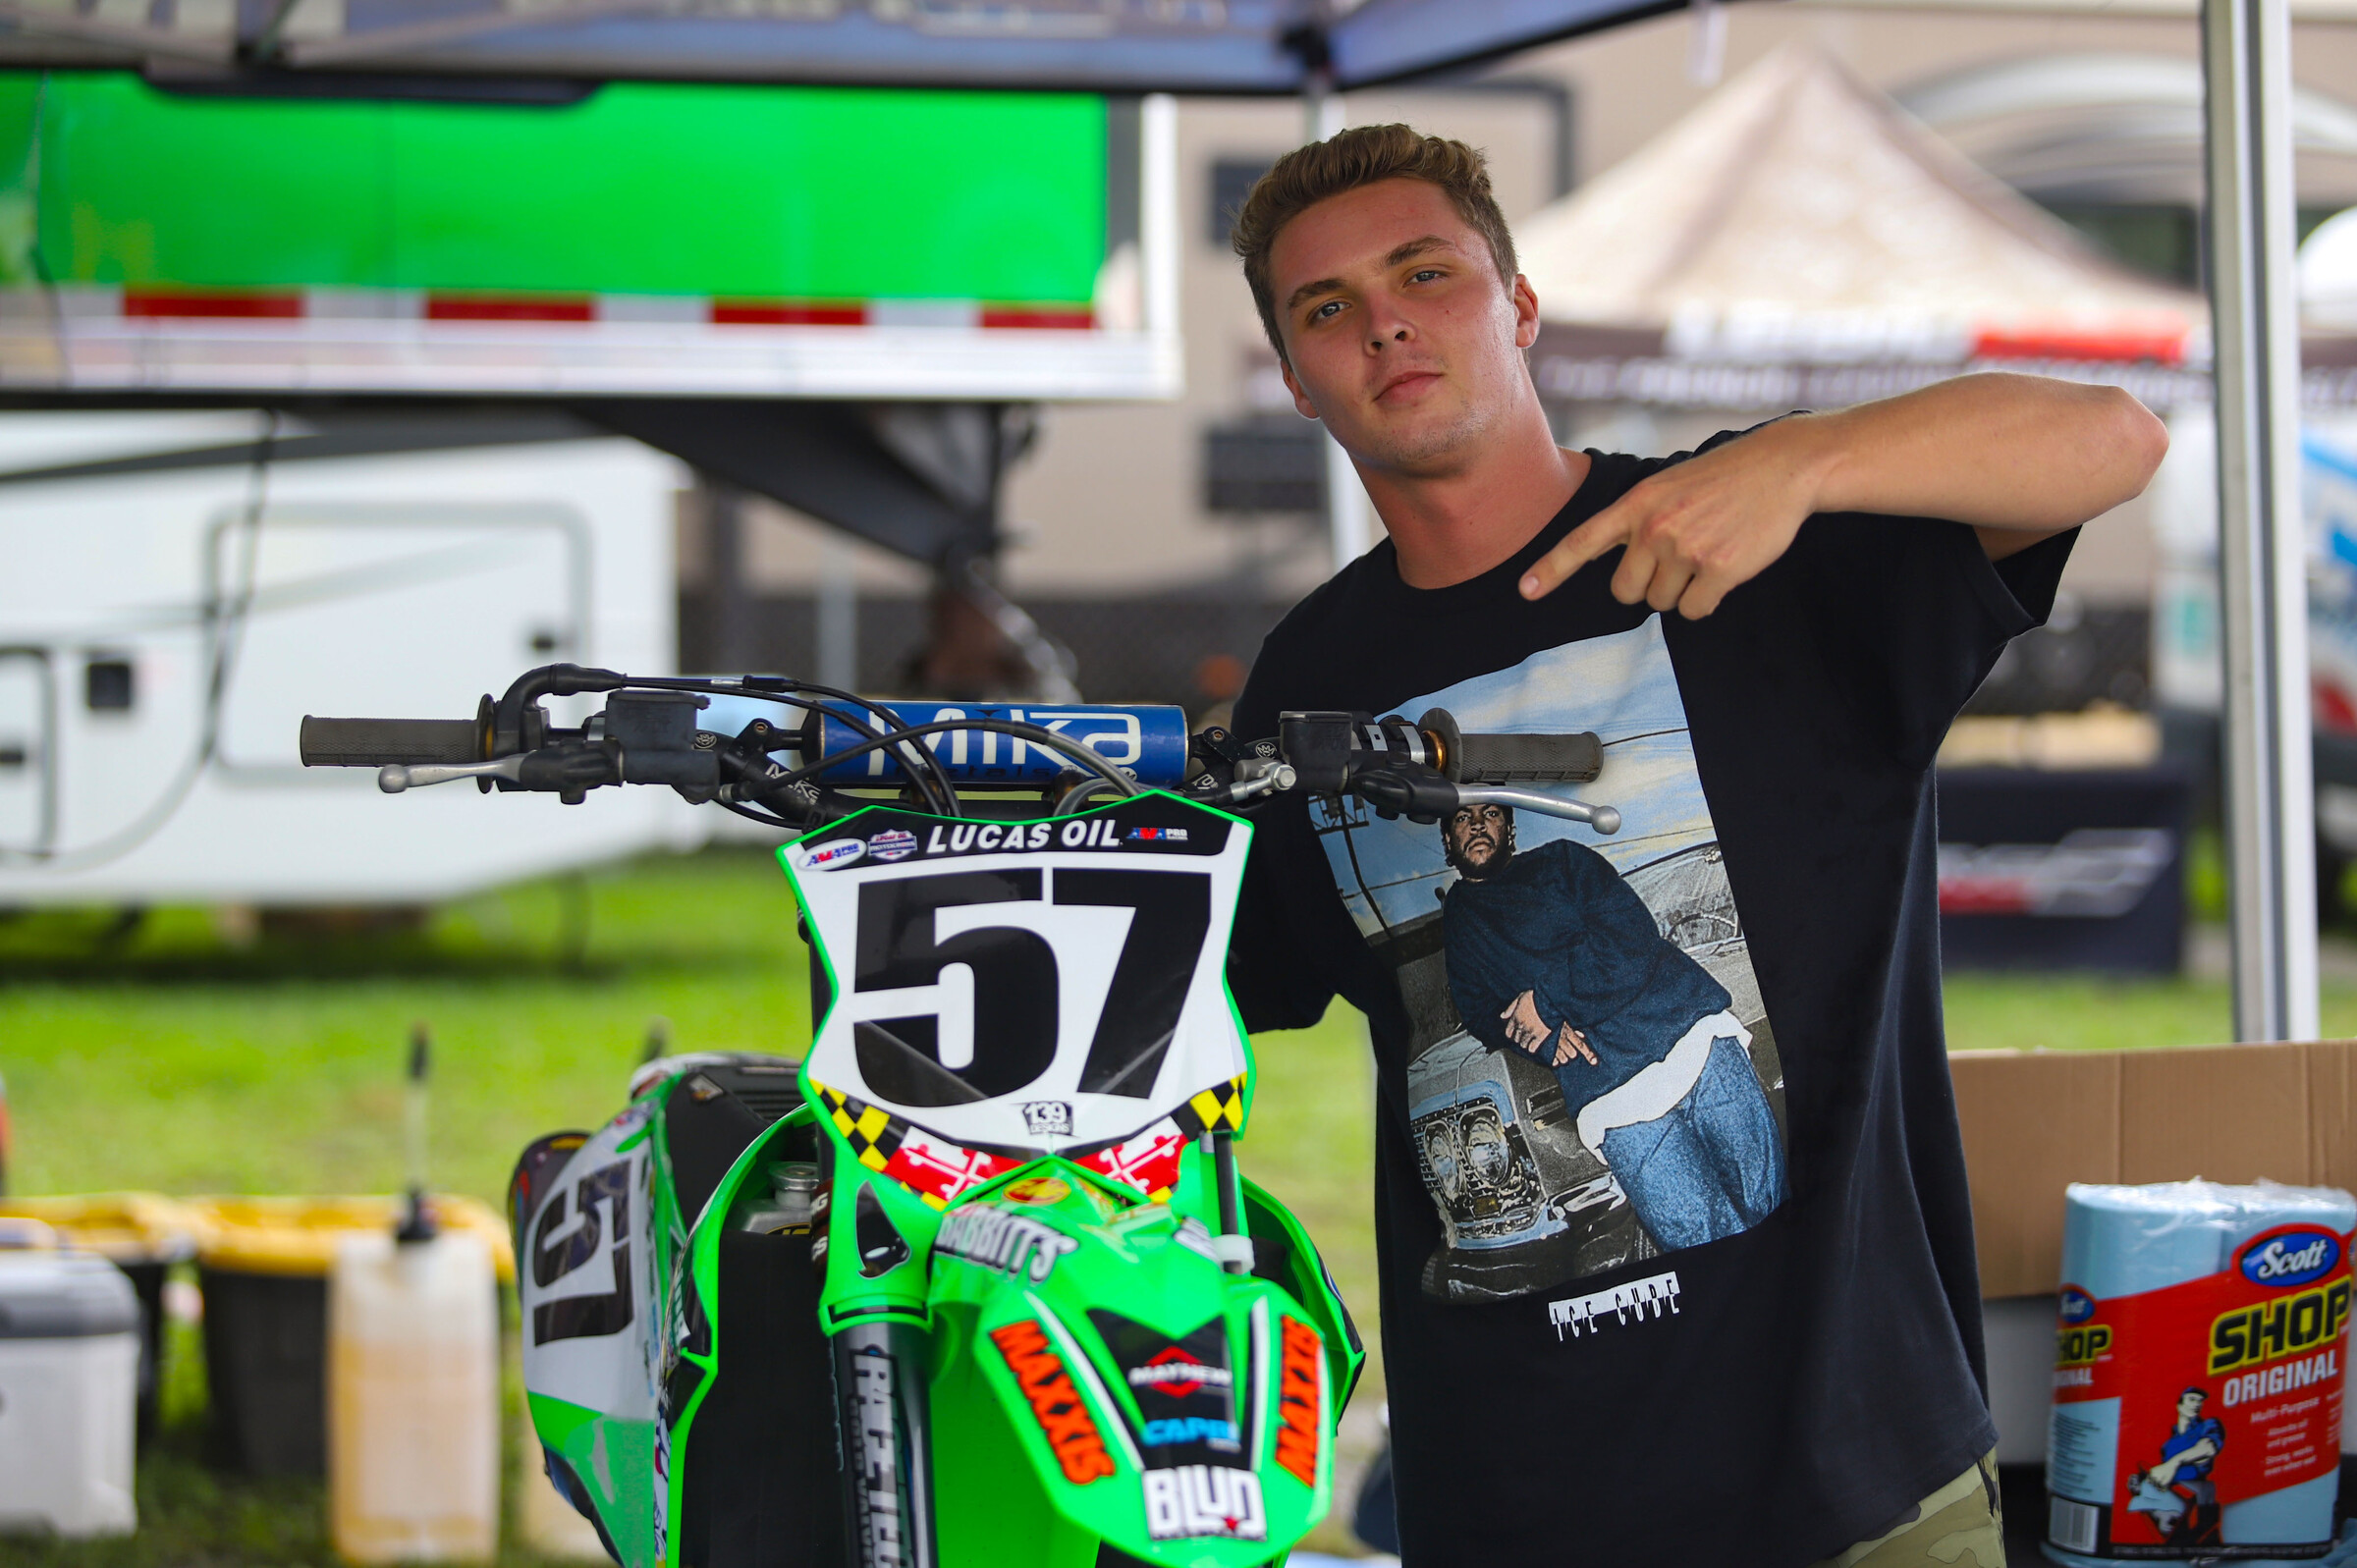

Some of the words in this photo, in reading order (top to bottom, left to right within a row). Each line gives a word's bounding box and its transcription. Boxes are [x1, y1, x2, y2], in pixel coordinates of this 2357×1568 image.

[926, 823, 1053, 853] LUCAS
[1062, 819, 1121, 847] OIL
[852, 867, 1213, 1108] 57
[1024, 1102, 1068, 1124] 139
[533, 1158, 634, 1348] 57
[2258, 1238, 2328, 1278] Scott
[1550, 1300, 1599, 1342] ICE
[1615, 1278, 1680, 1325] CUBE
[2209, 1275, 2351, 1376] SHOP
[853, 1353, 905, 1479] RACE
[989, 1319, 1117, 1486] MAXXIS
[1275, 1314, 1322, 1489] MAXXIS
[2221, 1349, 2338, 1408] ORIGINAL
